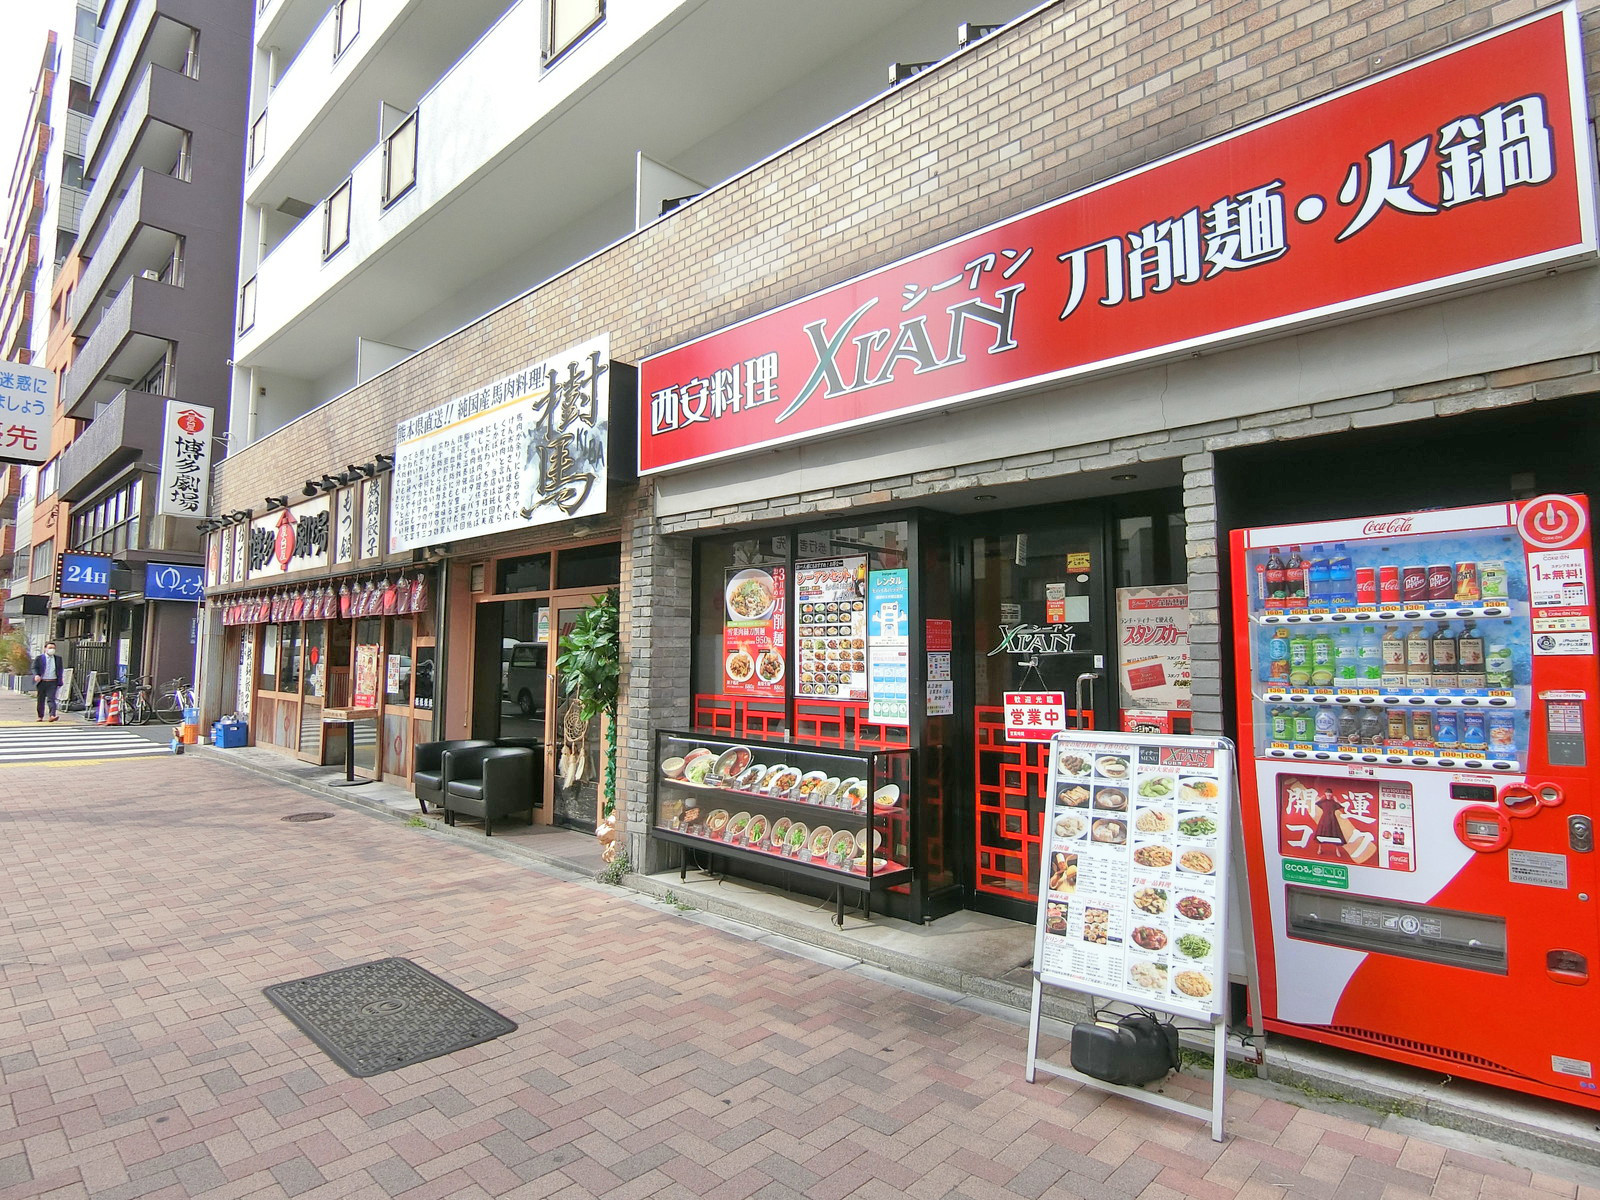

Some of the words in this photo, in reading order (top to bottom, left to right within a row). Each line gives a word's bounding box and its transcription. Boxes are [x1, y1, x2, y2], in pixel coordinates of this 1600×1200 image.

[1057, 92, 1557, 322] 刀削麺・火鍋
[900, 247, 1033, 312] シーアン
[0, 371, 47, 394] 迷惑に
[650, 351, 779, 437] 西安料理
[0, 422, 38, 451] 先
[169, 435, 206, 513] 博多劇場
[1362, 517, 1414, 535] Coca-Cola
[67, 565, 107, 585] 24H
[875, 576, 903, 586] レンタル
[1532, 563, 1583, 581] 1本無料!
[772, 597, 785, 647] 刀削麺
[1032, 623, 1074, 633] シーアン
[1123, 623, 1191, 646] スタンプカー
[1010, 708, 1059, 726] 営業中
[1285, 787, 1377, 824] 開運
[1286, 822, 1378, 858] コーク
